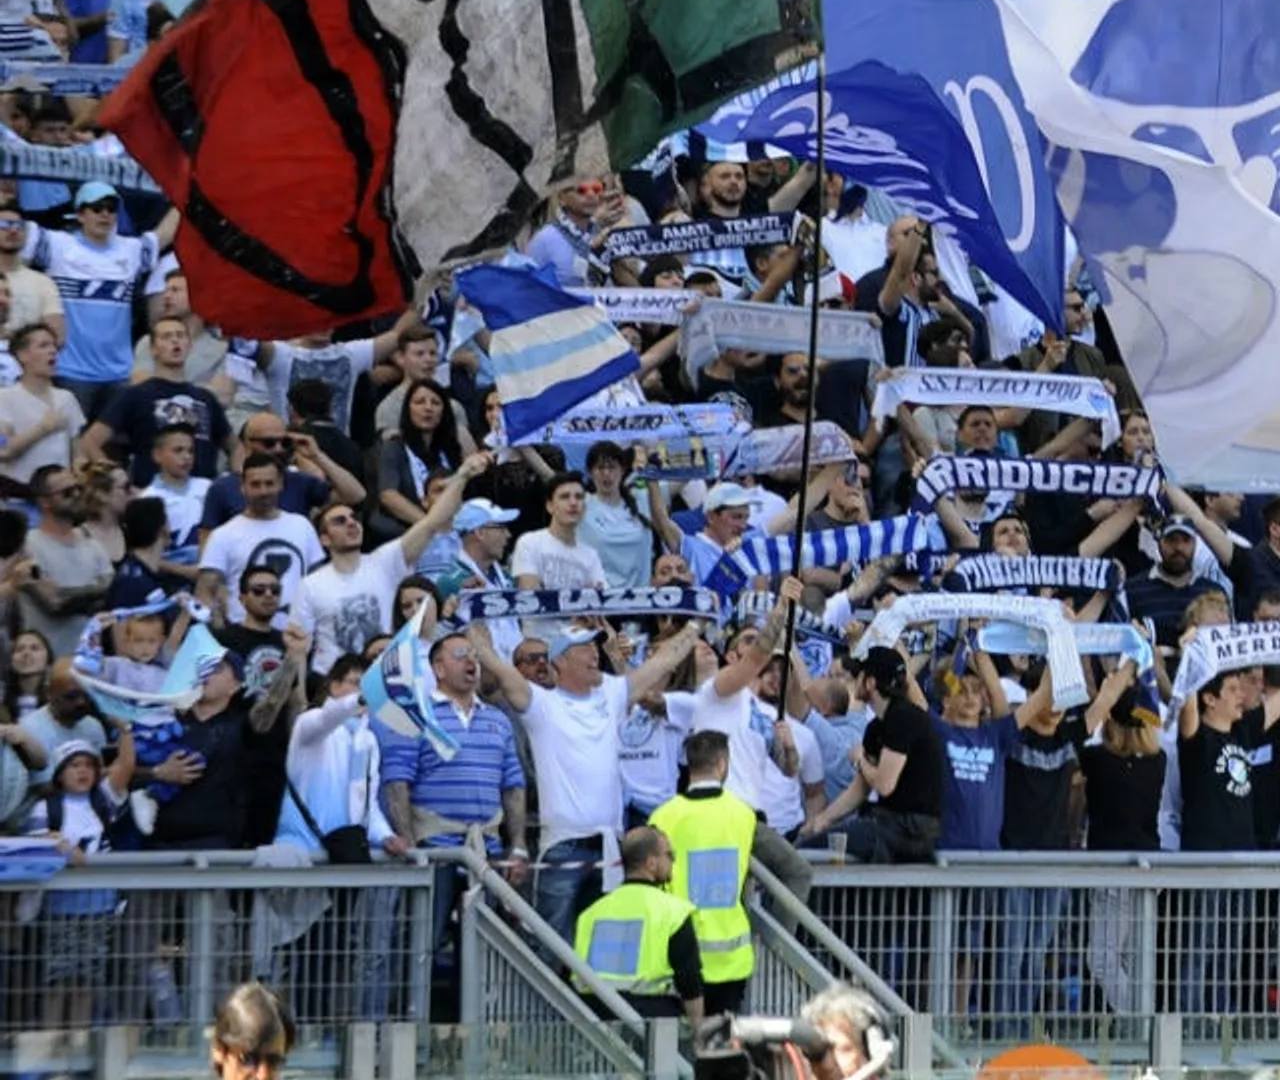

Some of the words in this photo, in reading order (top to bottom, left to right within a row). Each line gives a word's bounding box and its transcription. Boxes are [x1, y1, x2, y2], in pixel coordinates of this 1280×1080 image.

[954, 375, 1030, 395] LAZIO
[1036, 378, 1084, 402] 1900
[558, 586, 684, 612] LAZIO
